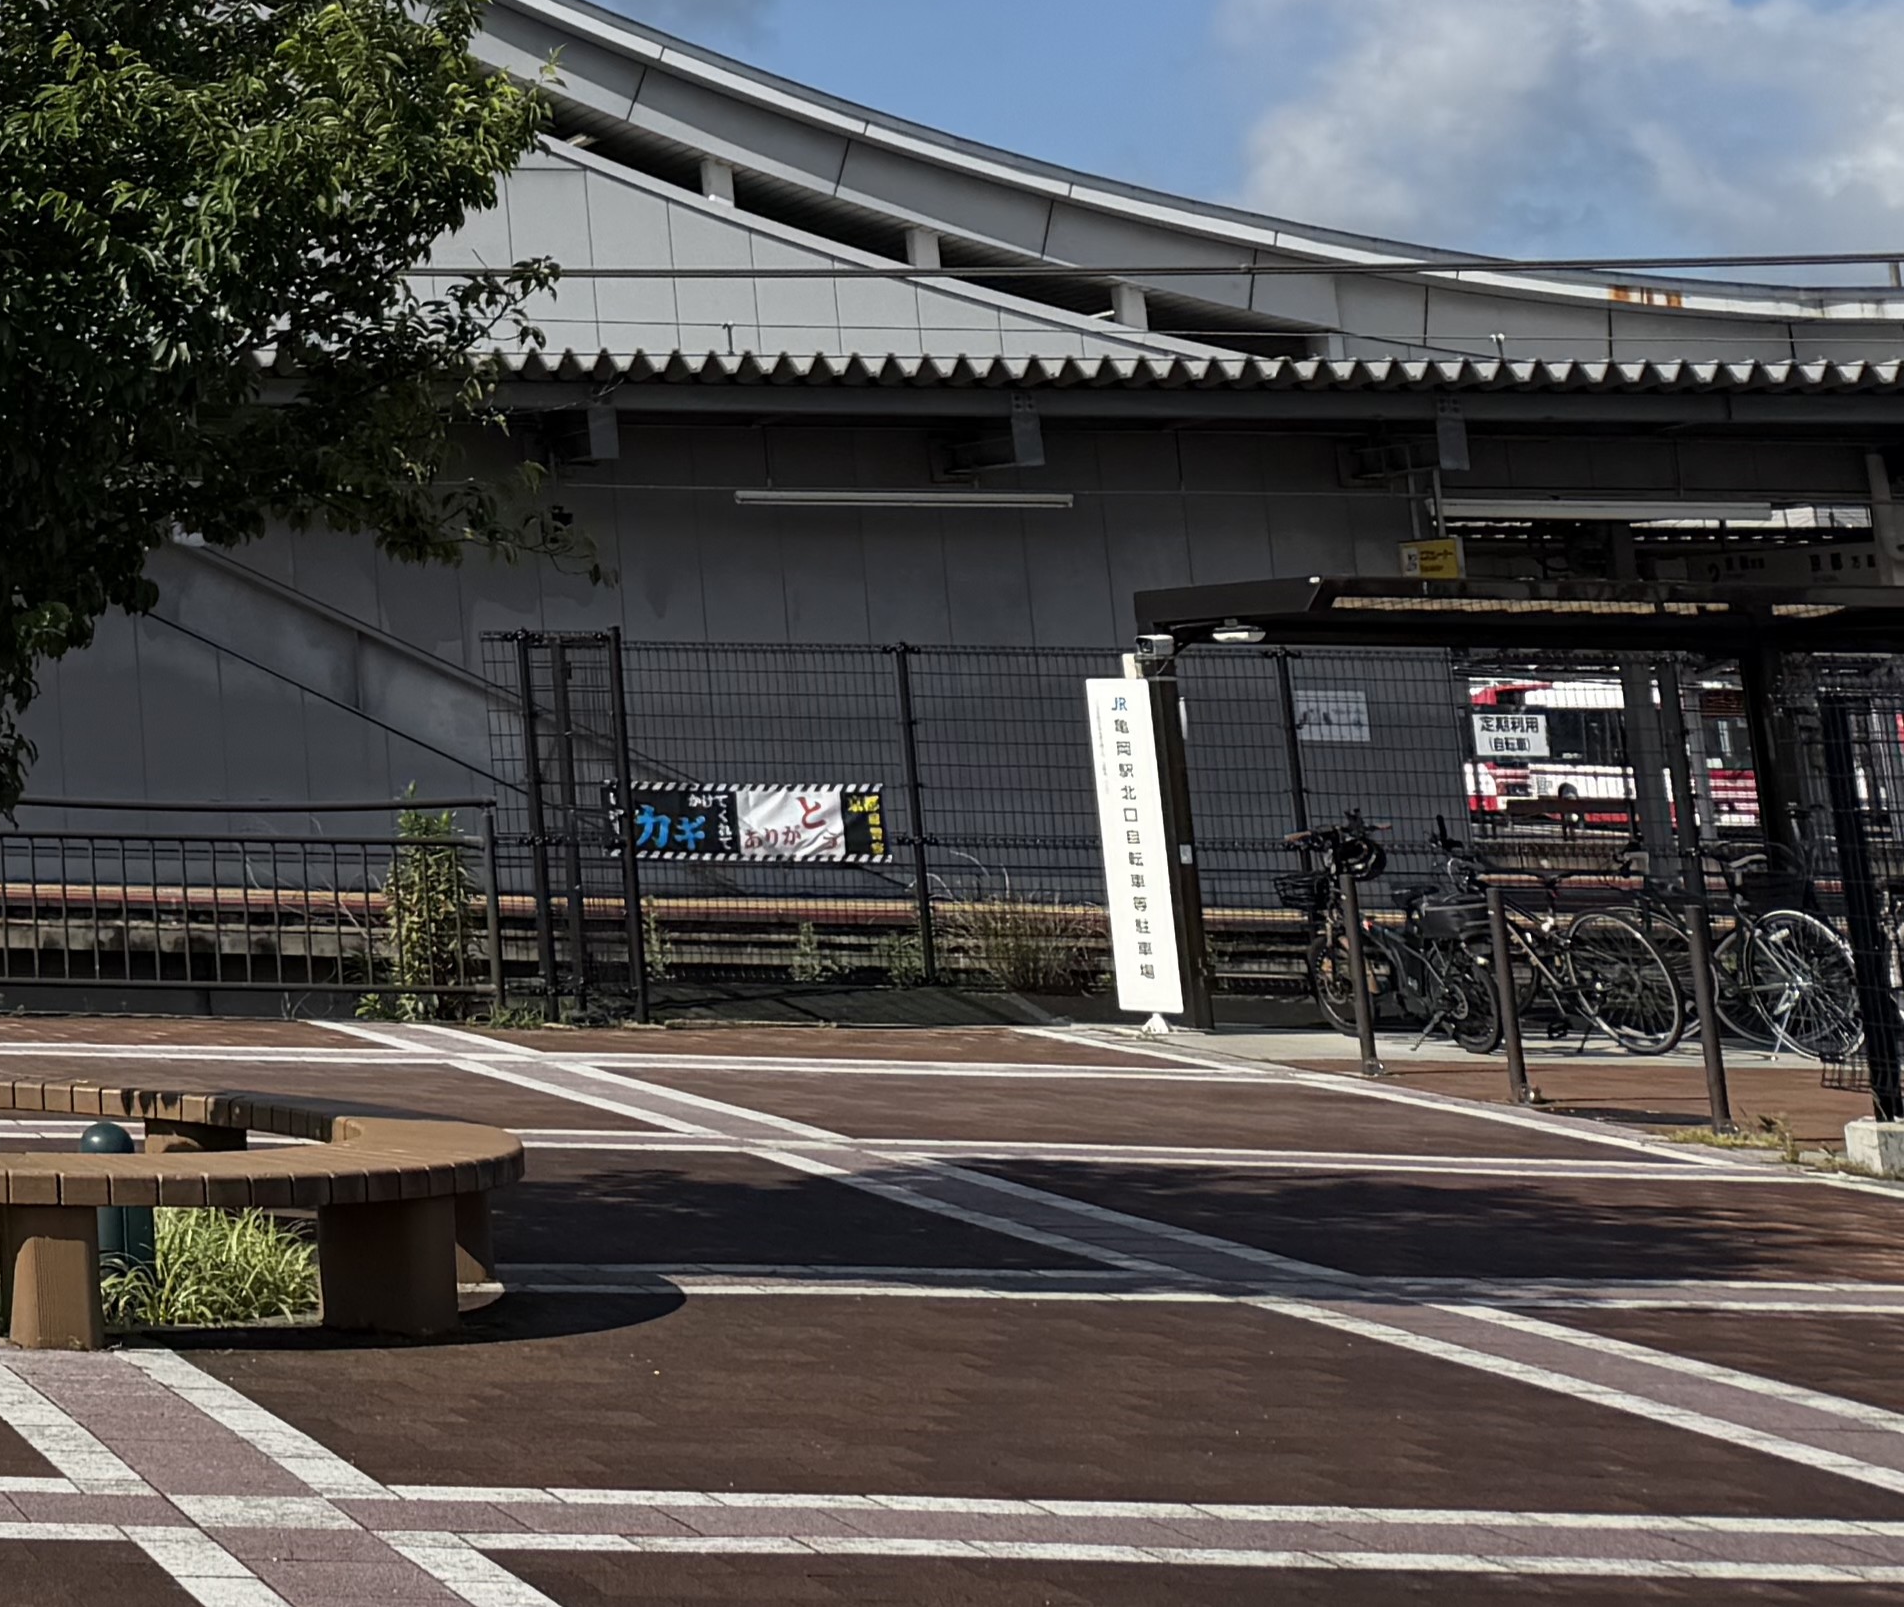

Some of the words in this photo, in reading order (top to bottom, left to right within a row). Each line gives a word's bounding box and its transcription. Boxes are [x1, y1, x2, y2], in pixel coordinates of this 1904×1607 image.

[1479, 716, 1539, 733] 定期利用
[634, 803, 708, 850] カギ
